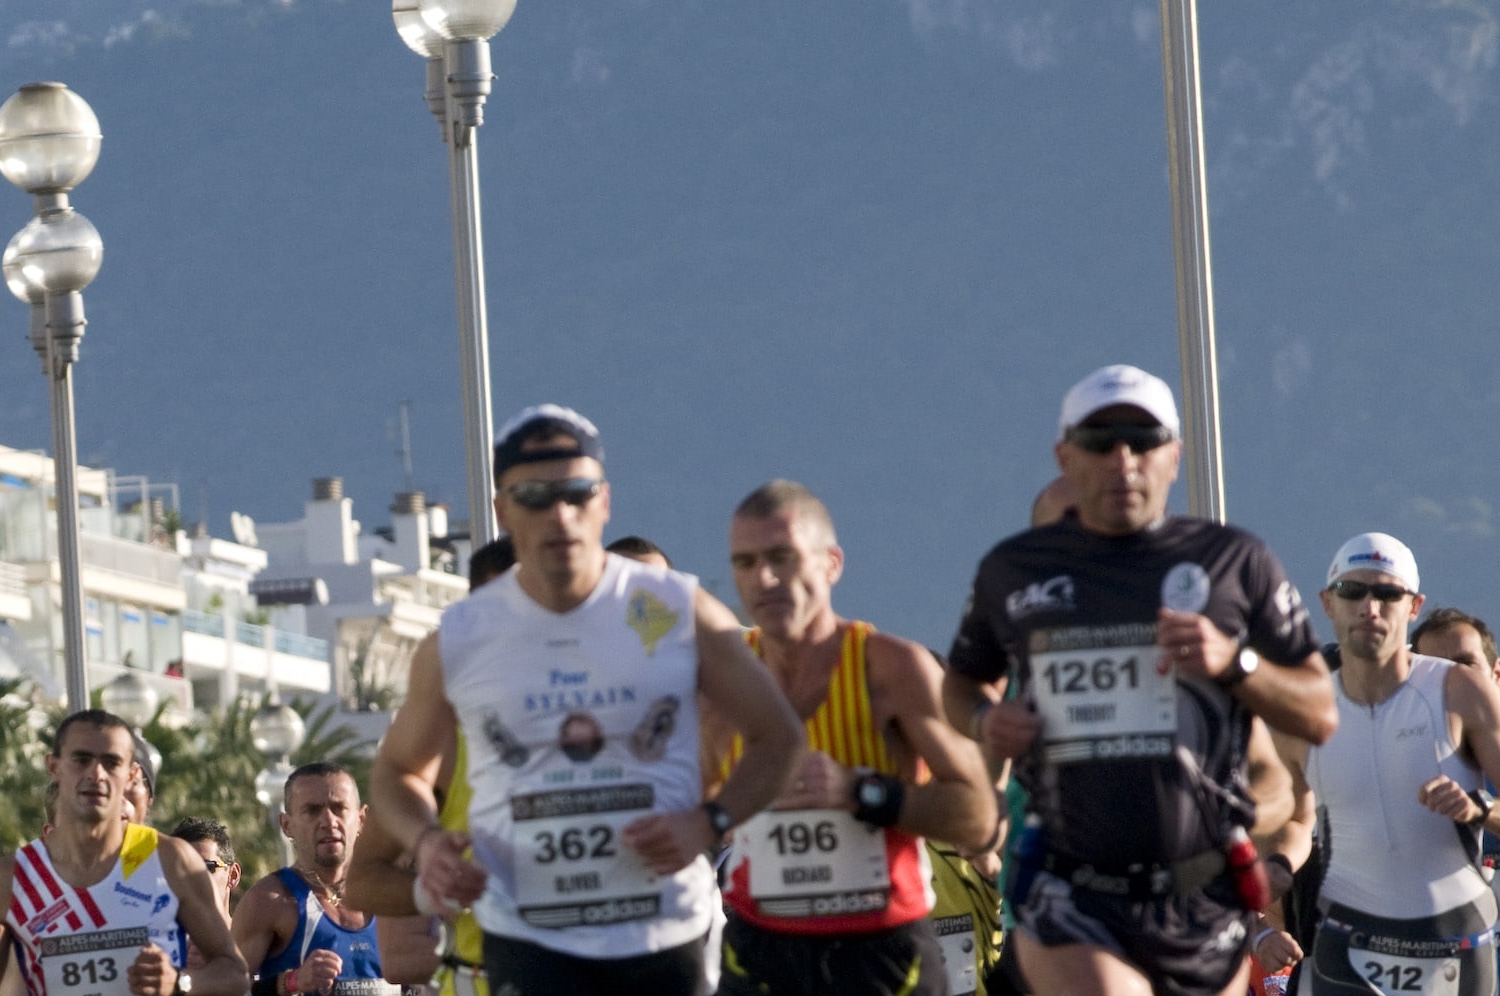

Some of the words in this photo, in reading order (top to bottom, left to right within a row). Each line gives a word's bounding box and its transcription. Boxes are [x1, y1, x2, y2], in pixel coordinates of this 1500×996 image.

[1043, 656, 1140, 694] 1261
[523, 686, 636, 711] SYLVAIN
[1099, 737, 1172, 757] adidas
[533, 824, 617, 865] 362
[768, 820, 839, 856] 196
[583, 899, 655, 922] adidas
[813, 893, 886, 915] adidas
[59, 929, 148, 948] ALPES-MARITIMES
[61, 956, 119, 987] 813
[1364, 961, 1423, 991] 212
